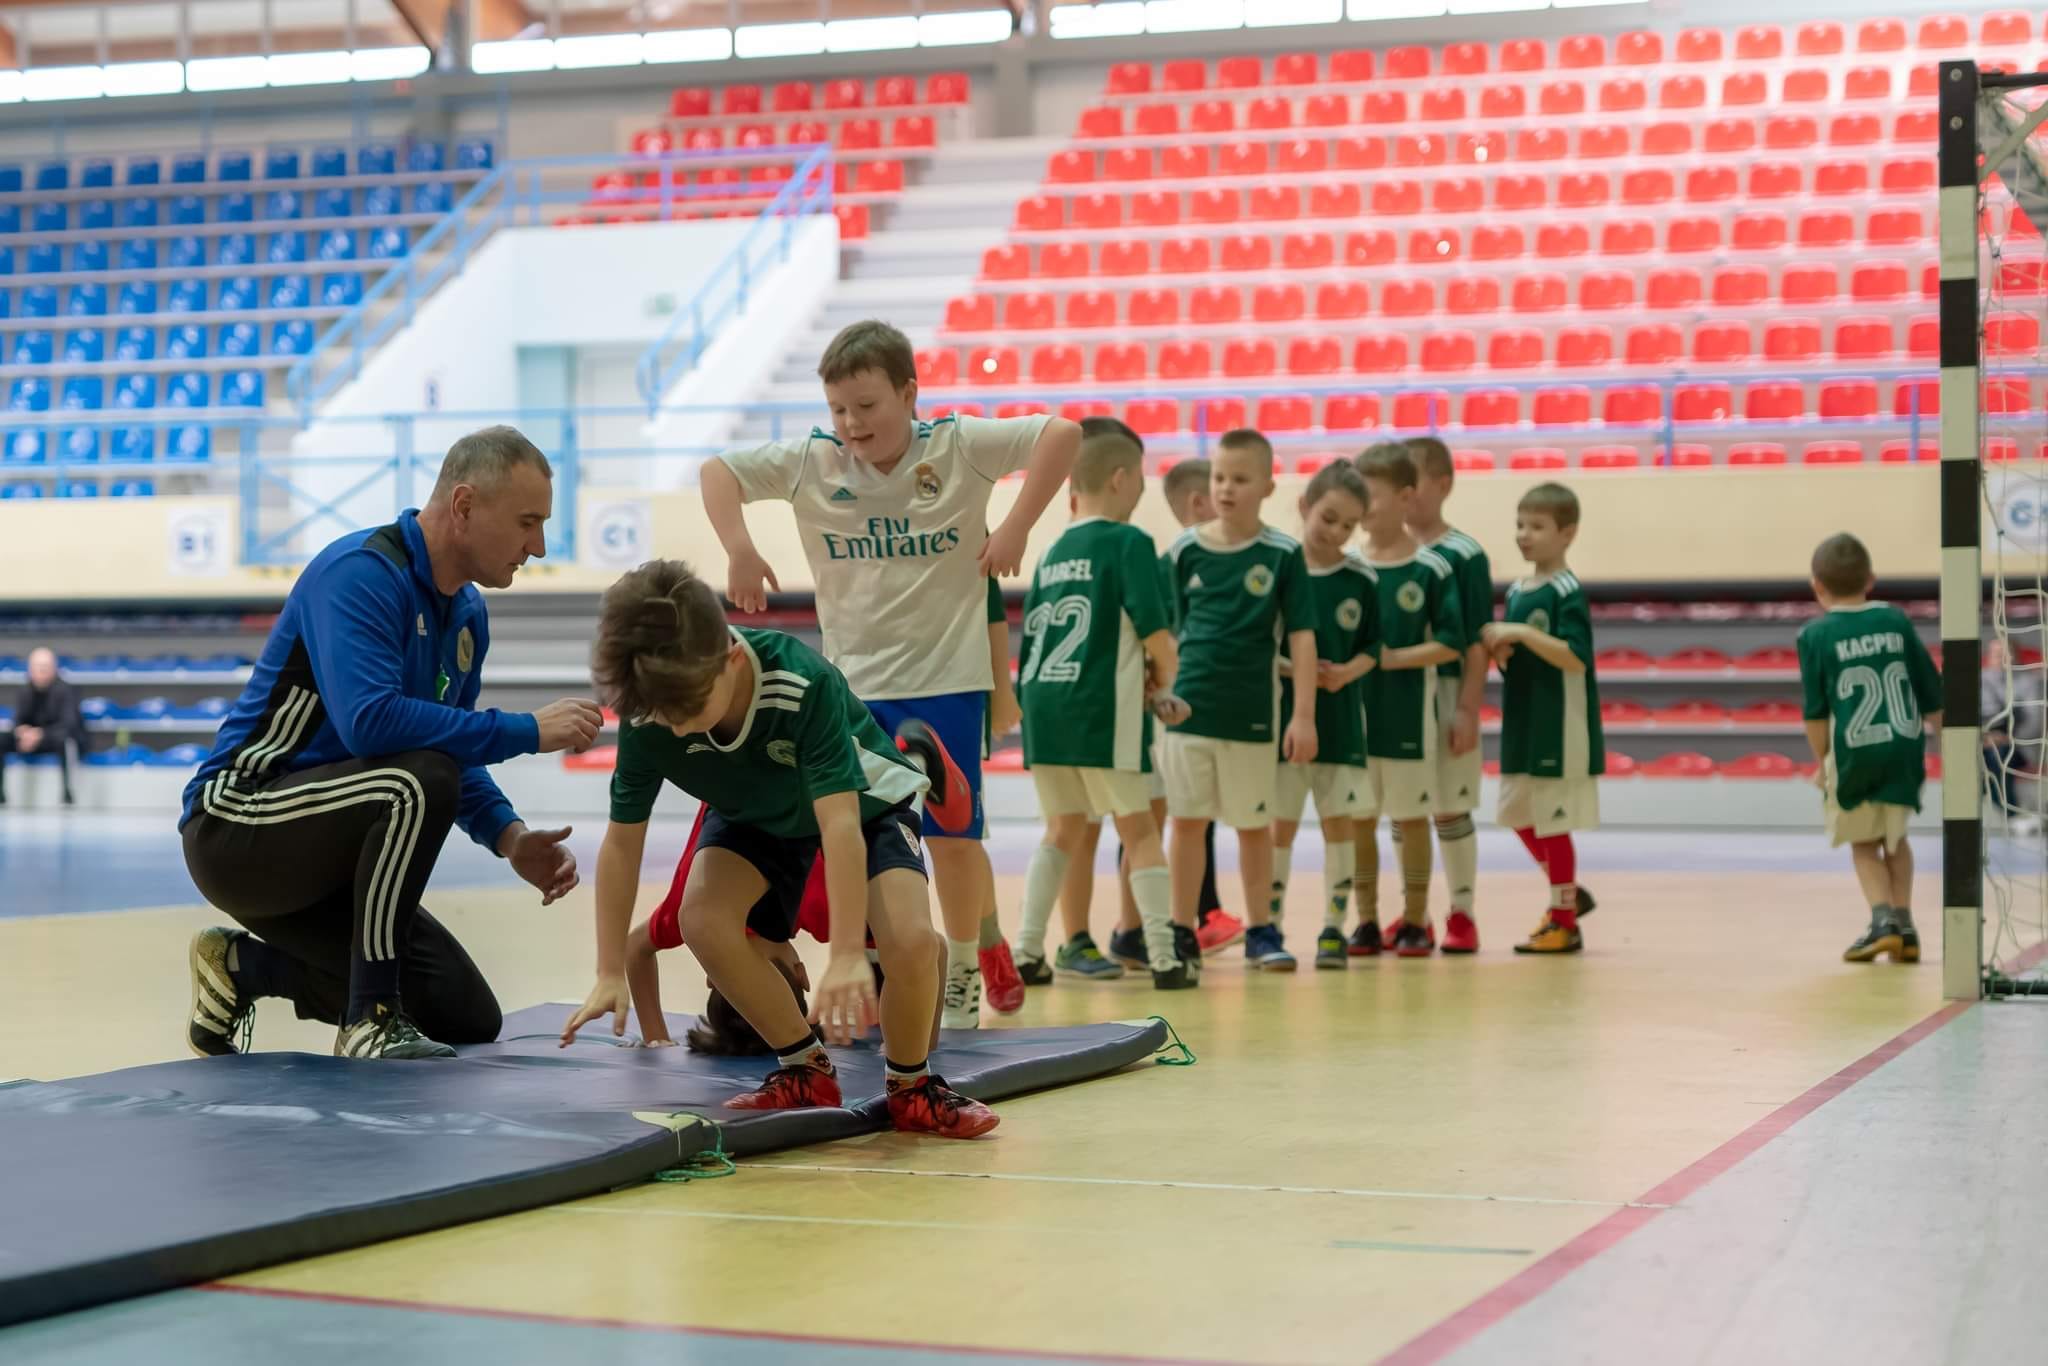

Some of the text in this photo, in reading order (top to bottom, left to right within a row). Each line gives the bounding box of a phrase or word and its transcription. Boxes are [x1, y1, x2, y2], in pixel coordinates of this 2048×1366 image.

[602, 523, 637, 549] C1
[822, 526, 961, 560] Emirates
[867, 516, 910, 537] Fly
[1020, 594, 1092, 686] 12
[1836, 660, 1923, 749] 20
